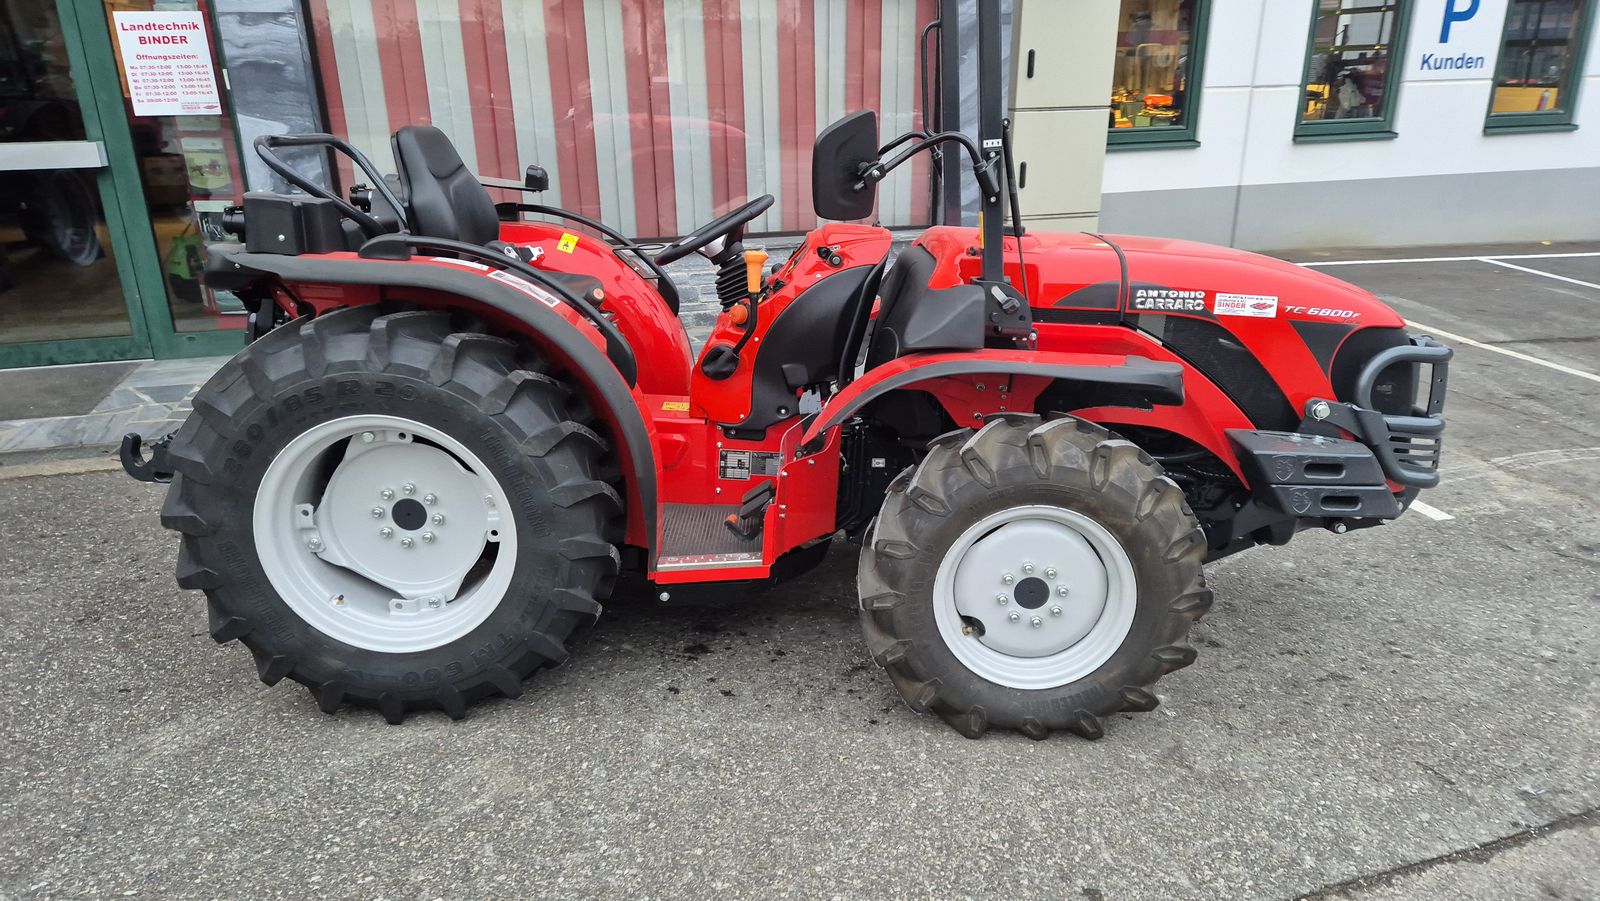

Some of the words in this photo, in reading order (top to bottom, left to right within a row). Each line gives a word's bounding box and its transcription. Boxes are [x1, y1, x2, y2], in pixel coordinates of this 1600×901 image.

[120, 22, 200, 31] Landtechnik
[1439, 0, 1480, 44] P
[138, 35, 188, 45] BINDER
[1420, 53, 1484, 71] Kunden
[1136, 290, 1206, 298] ANTONIO
[1135, 298, 1205, 311] CARRARO
[1217, 302, 1247, 310] BINDER
[1285, 305, 1307, 314] TC
